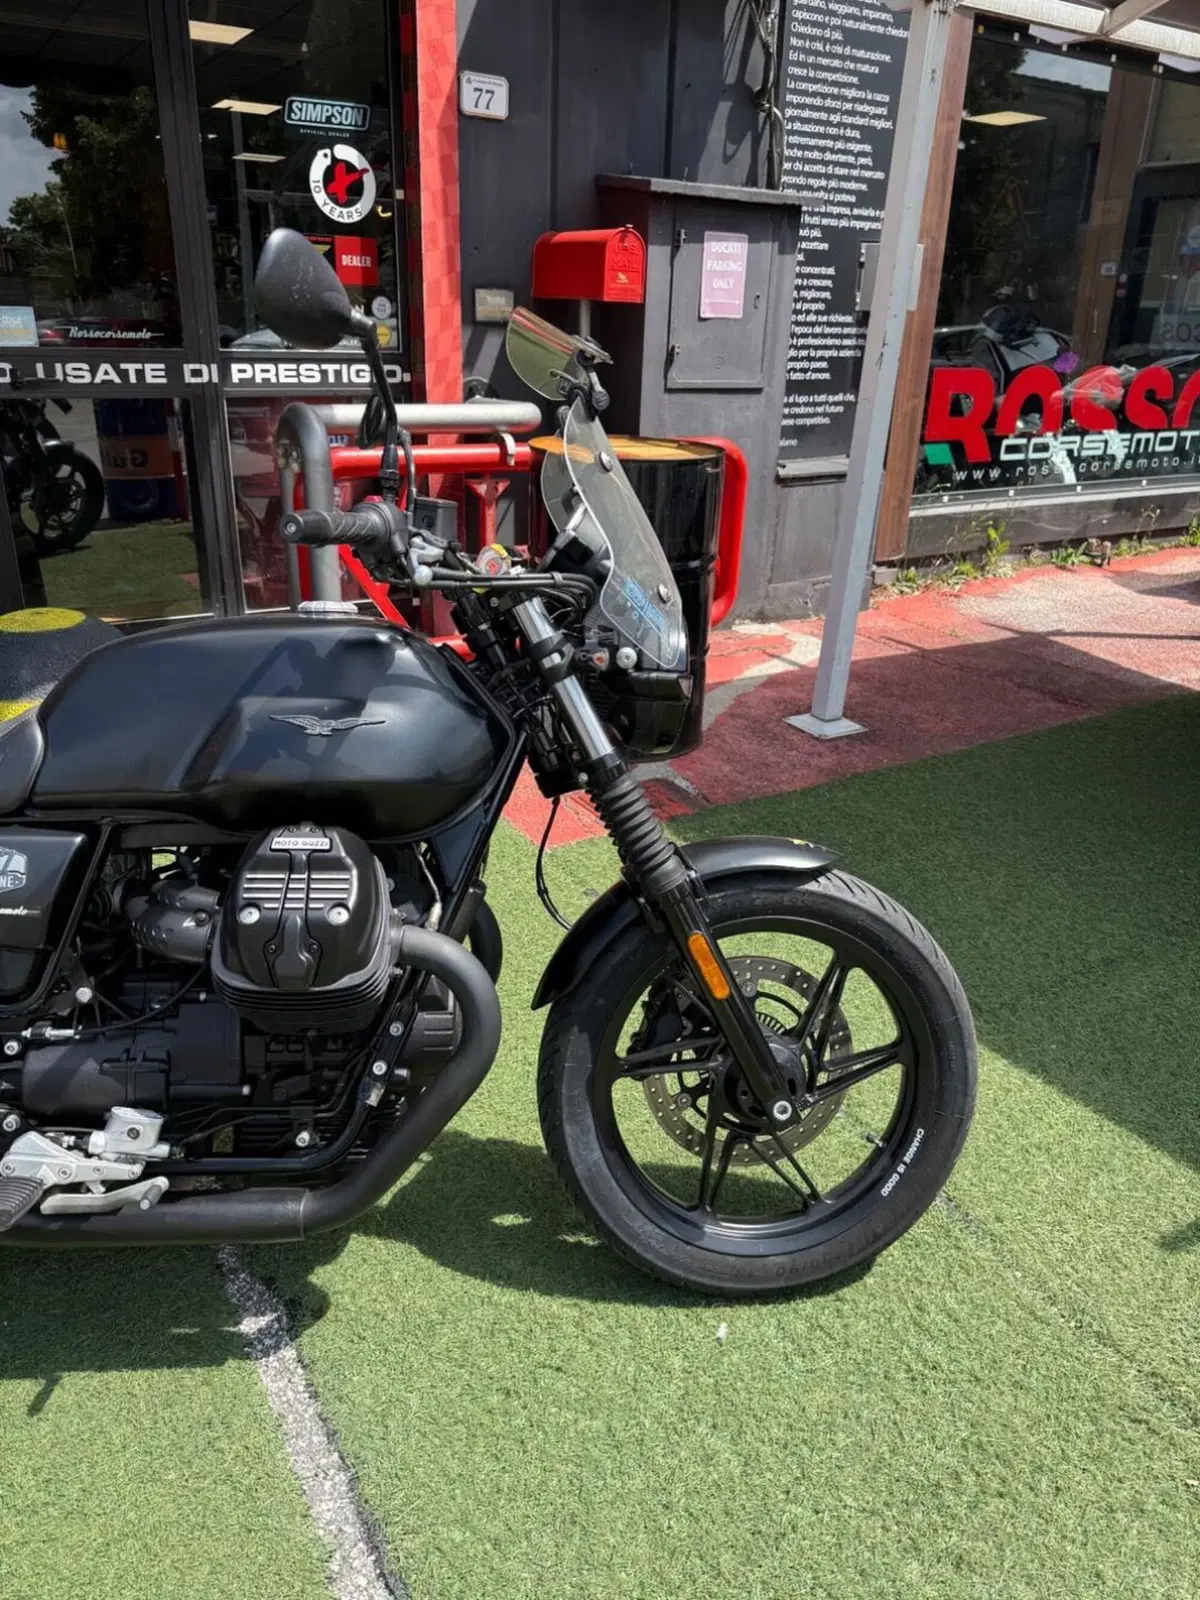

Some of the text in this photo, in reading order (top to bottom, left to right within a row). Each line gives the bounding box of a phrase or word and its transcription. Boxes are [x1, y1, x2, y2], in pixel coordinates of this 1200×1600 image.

[791, 9, 824, 22] capiscono
[830, 16, 841, 26] poi
[842, 19, 884, 34] naturalmente
[885, 25, 909, 37] chiedon
[791, 22, 823, 36] Chiedono
[823, 28, 831, 38] di
[790, 36, 804, 47] Non
[805, 39, 810, 49] è
[825, 42, 830, 52] è
[831, 44, 843, 54] crisi
[843, 46, 851, 55] di
[789, 50, 799, 60] Ed
[799, 51, 806, 62] in
[807, 55, 816, 64] un
[817, 57, 843, 68] mercato
[844, 58, 855, 70] che
[787, 66, 808, 77] cresce
[808, 67, 815, 77] la
[786, 78, 795, 88] La
[796, 82, 839, 95] competizione
[866, 90, 872, 100] la
[473, 87, 496, 110] 77
[786, 93, 824, 106] imponendo
[842, 102, 853, 111] per
[290, 101, 364, 126] SIMPSON
[785, 107, 828, 120] giornalmente
[829, 112, 841, 124] agli
[841, 115, 869, 126] standard
[784, 119, 792, 130] La
[793, 121, 826, 133] situazione
[826, 126, 839, 136] non
[840, 126, 845, 136] è
[788, 135, 834, 148] estremamente
[834, 139, 845, 150] più
[803, 149, 822, 160] molto
[792, 160, 803, 171] chi
[826, 164, 833, 174] di
[849, 167, 860, 177] nel
[807, 177, 828, 189] regole
[828, 178, 839, 190] più
[312, 179, 363, 221] 10 YEARS
[838, 217, 849, 229] più
[711, 241, 741, 254] DUCATI
[341, 254, 372, 268] DEALER
[706, 259, 743, 272] PARKING
[712, 278, 735, 289] ONLY
[802, 300, 826, 312] proprio
[816, 348, 838, 358] propria
[36, 363, 167, 384] USATE
[183, 363, 218, 383] DI
[230, 363, 411, 384] PRESTIGO.
[903, 1128, 925, 1164] CHANGE
[896, 1163, 906, 1174] IS
[880, 1172, 900, 1197] GOOD
